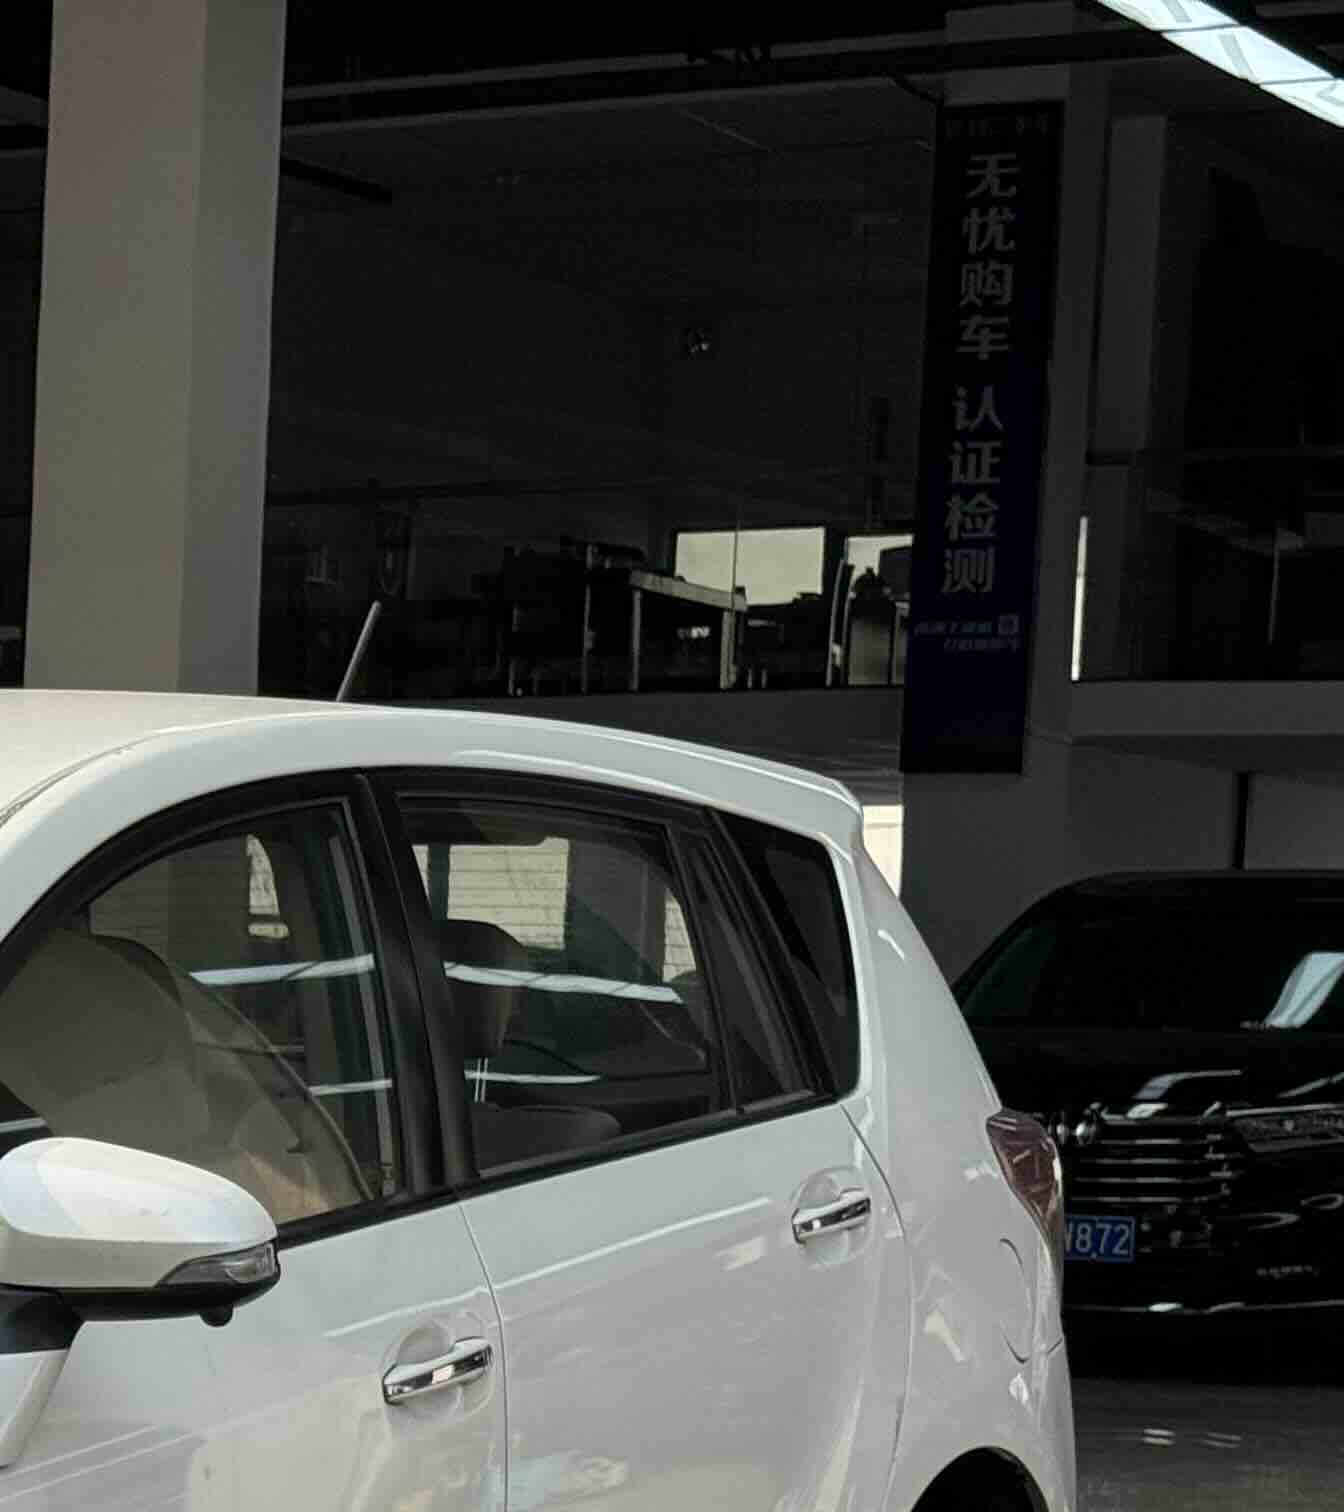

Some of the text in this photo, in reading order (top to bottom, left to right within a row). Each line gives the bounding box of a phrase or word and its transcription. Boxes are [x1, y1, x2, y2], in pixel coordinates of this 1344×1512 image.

[954, 152, 1022, 360] 无忧购车
[940, 384, 1006, 593] 认证检测
